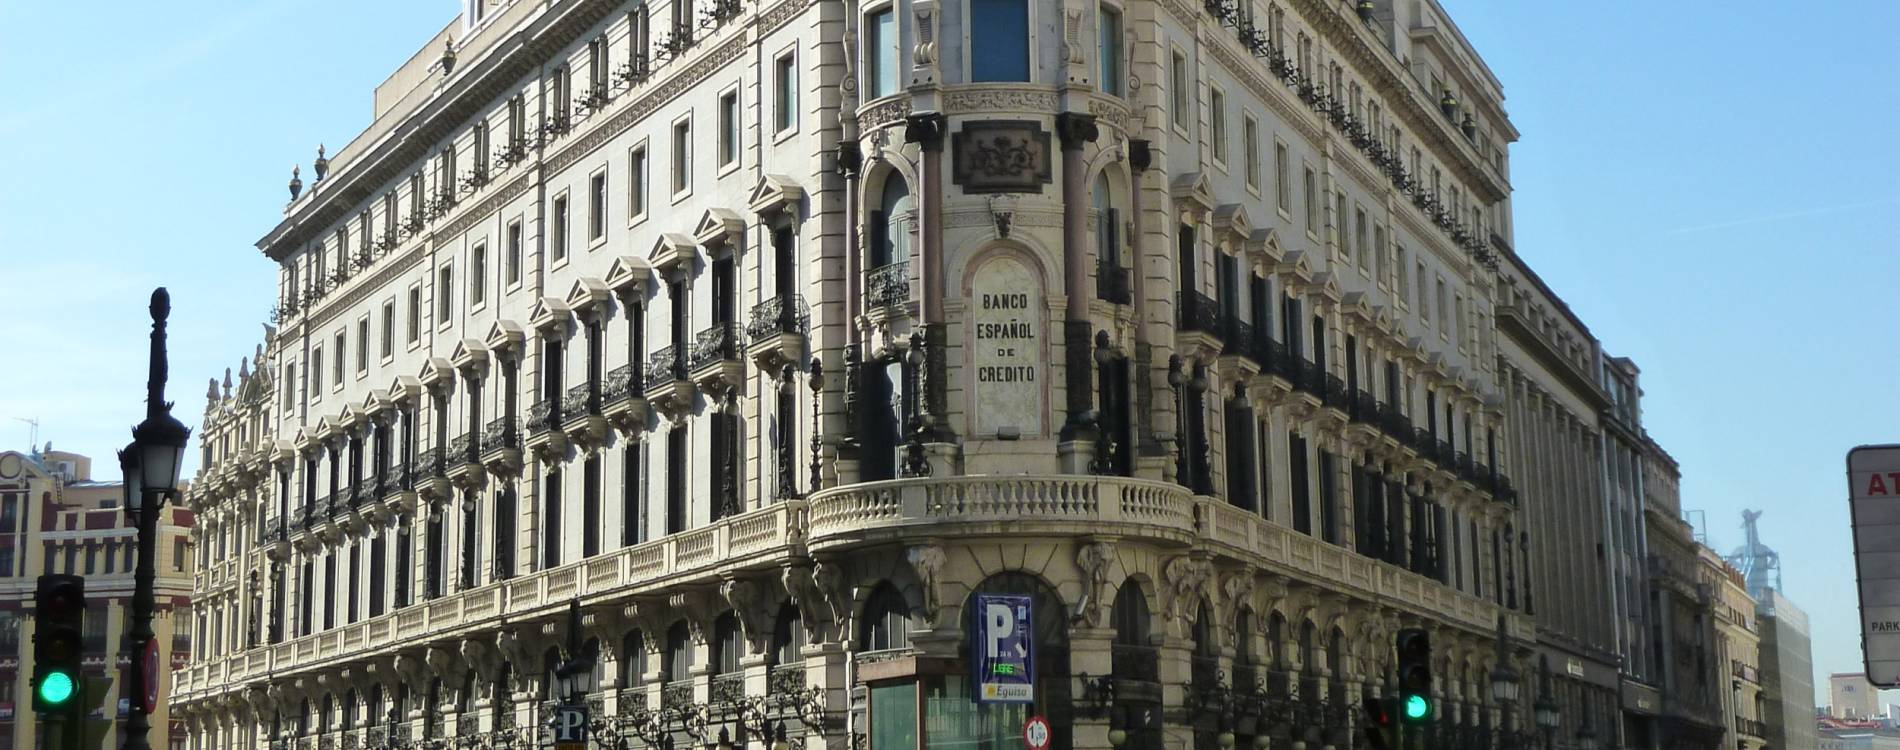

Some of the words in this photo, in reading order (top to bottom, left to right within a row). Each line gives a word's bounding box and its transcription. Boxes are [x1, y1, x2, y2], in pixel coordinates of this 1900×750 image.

[983, 294, 1027, 309] BANCO
[977, 319, 1035, 339] ESPAÑOL
[998, 349, 1015, 357] DE
[979, 366, 1035, 382] CREDITO
[986, 604, 1014, 658] P
[559, 711, 583, 740] P
